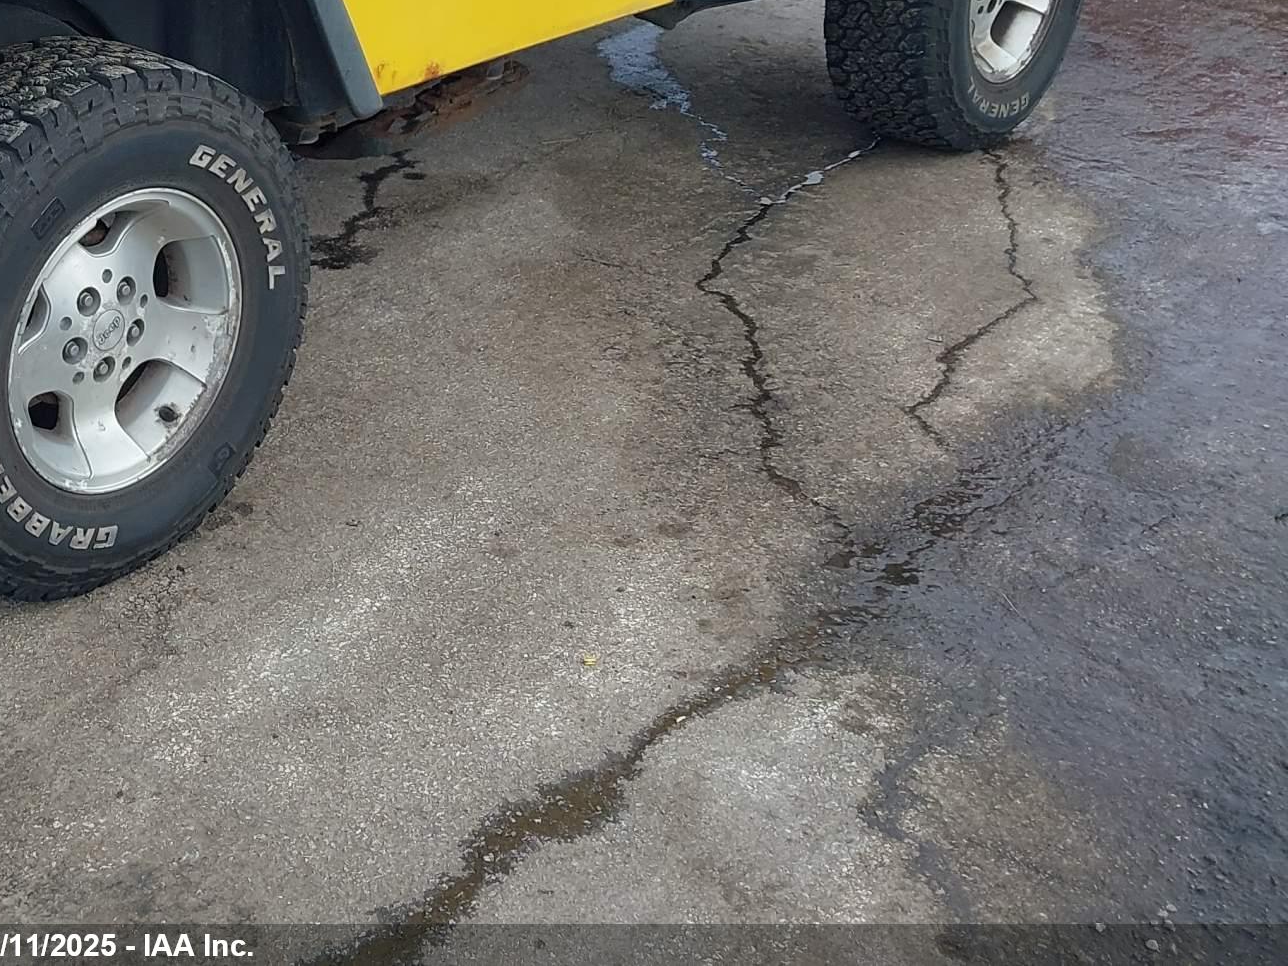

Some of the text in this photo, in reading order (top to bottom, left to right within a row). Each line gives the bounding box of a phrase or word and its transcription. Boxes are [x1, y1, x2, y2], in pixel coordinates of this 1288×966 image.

[968, 75, 1031, 119] GENERAL
[188, 144, 286, 290] GENERAL
[97, 314, 122, 346] Jeep
